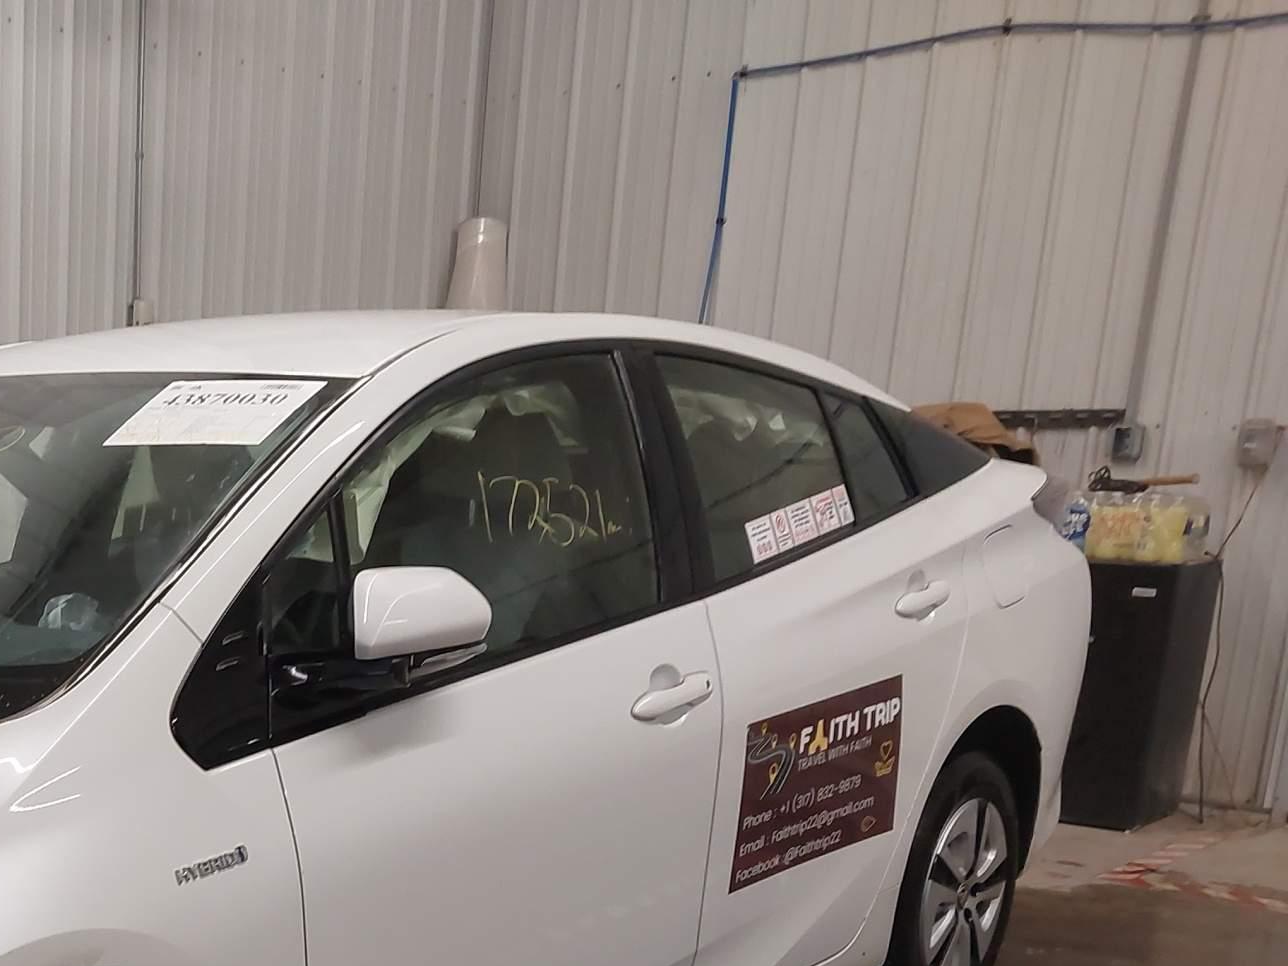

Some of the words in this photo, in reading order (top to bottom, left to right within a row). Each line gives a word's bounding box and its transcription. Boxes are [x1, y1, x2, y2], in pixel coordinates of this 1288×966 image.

[863, 696, 901, 732] TRIP
[828, 743, 850, 762] WITH
[742, 810, 772, 831] Phone
[739, 834, 765, 858] Email
[735, 855, 781, 883] Facebook
